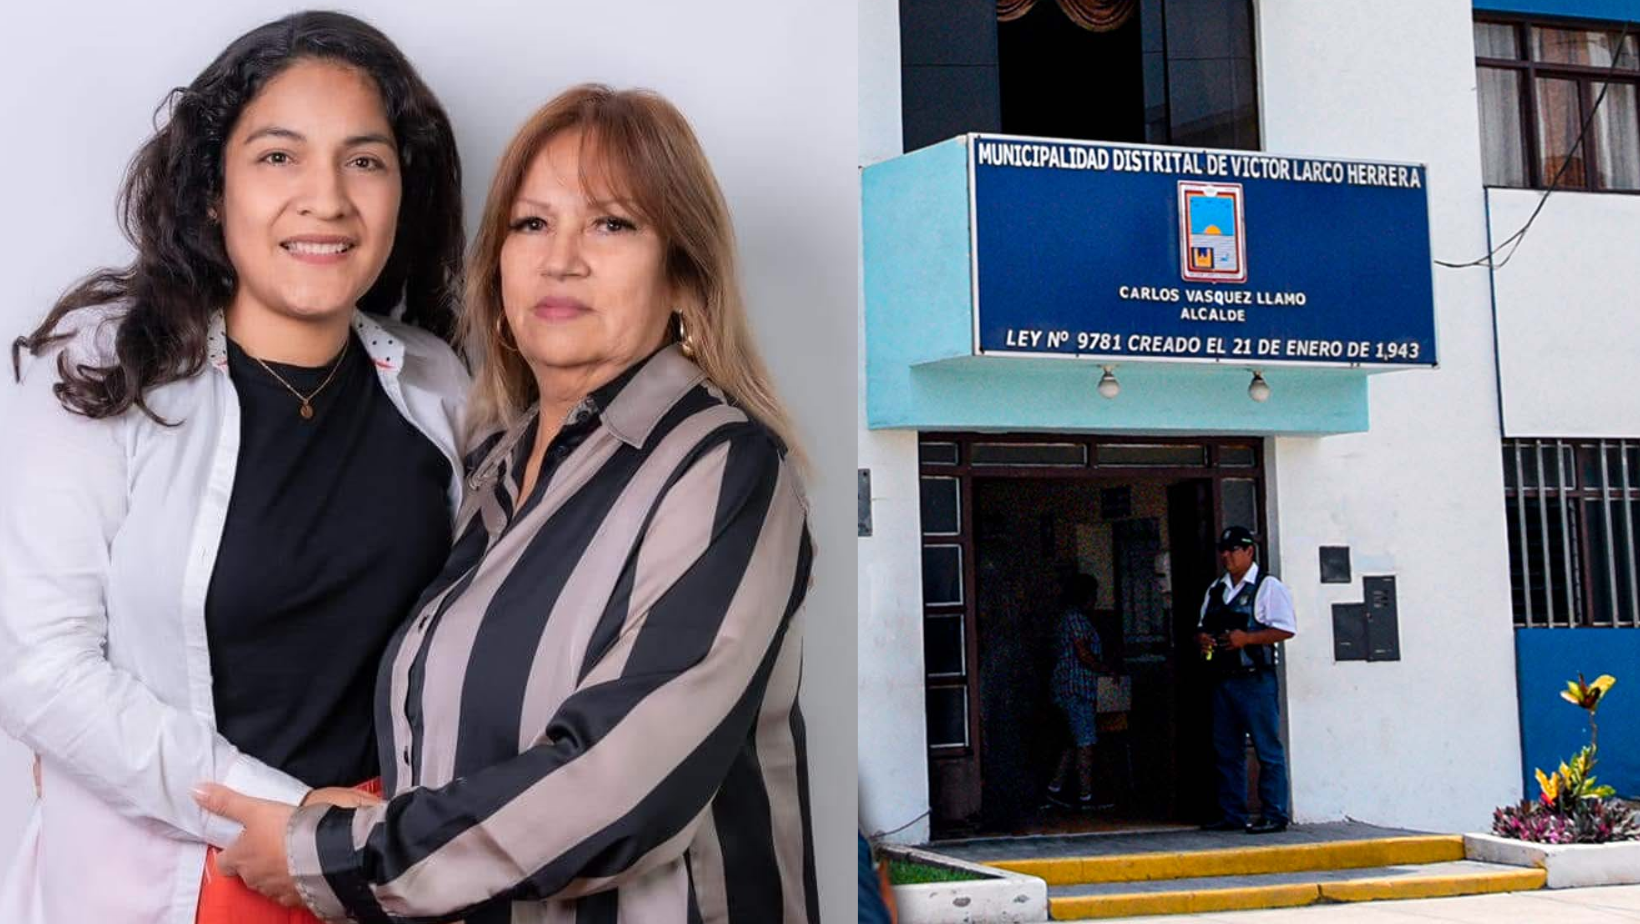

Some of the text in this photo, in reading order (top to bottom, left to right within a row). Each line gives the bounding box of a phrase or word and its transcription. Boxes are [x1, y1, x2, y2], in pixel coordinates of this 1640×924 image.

[978, 142, 1421, 188] MUNICIPALIDAD DISTRITAL DE VICTOR LARCO HERRERA
[1119, 286, 1306, 305] CARLOS VASQUEZ LLAMO
[1180, 307, 1246, 322] ALCALDE
[1006, 329, 1043, 347] LEY
[1077, 332, 1121, 350] 9781
[1127, 335, 1201, 353] CREADO
[1206, 337, 1226, 354] EL
[1232, 338, 1252, 355] 21
[1258, 339, 1281, 355] DE
[1286, 340, 1343, 357] ENERO
[1347, 341, 1370, 358] DE
